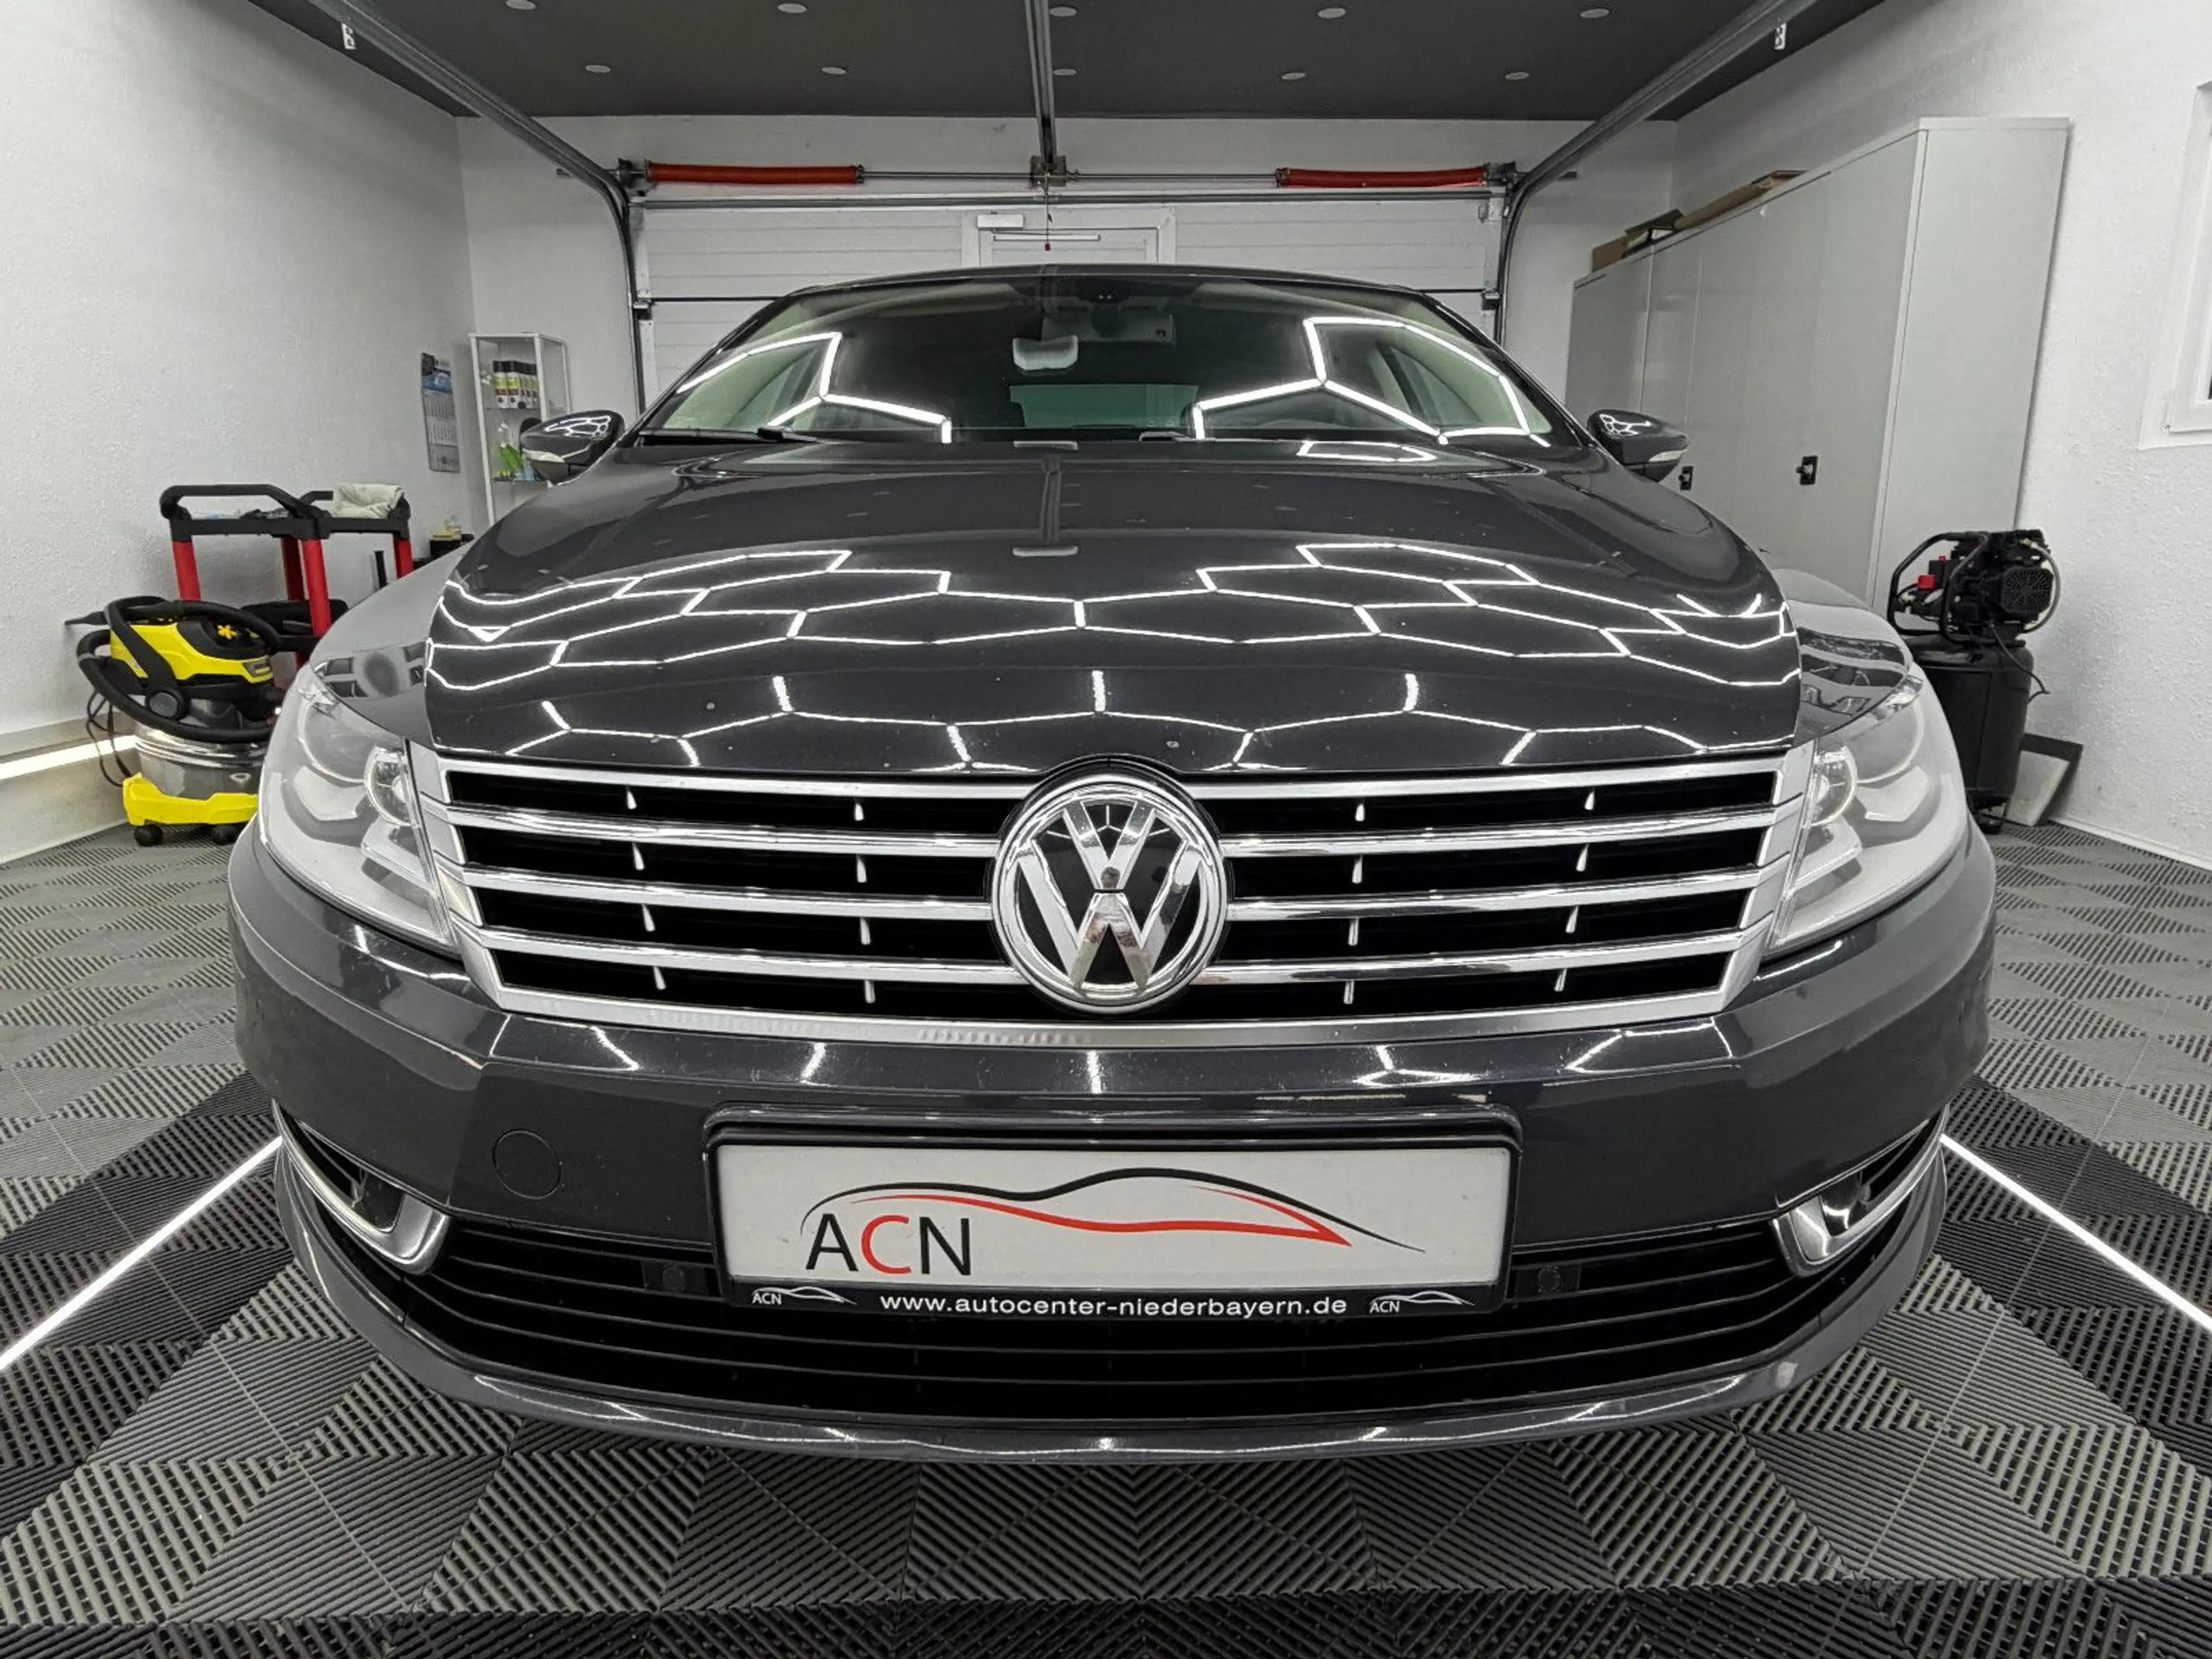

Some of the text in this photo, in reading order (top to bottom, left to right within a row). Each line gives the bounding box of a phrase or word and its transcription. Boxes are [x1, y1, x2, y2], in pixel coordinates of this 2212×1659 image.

[806, 1213, 971, 1275] ACN
[752, 1293, 782, 1305] ACN
[880, 1296, 1347, 1319] www.autocenter-niederbayern.de
[1369, 1301, 1400, 1314] ACN
